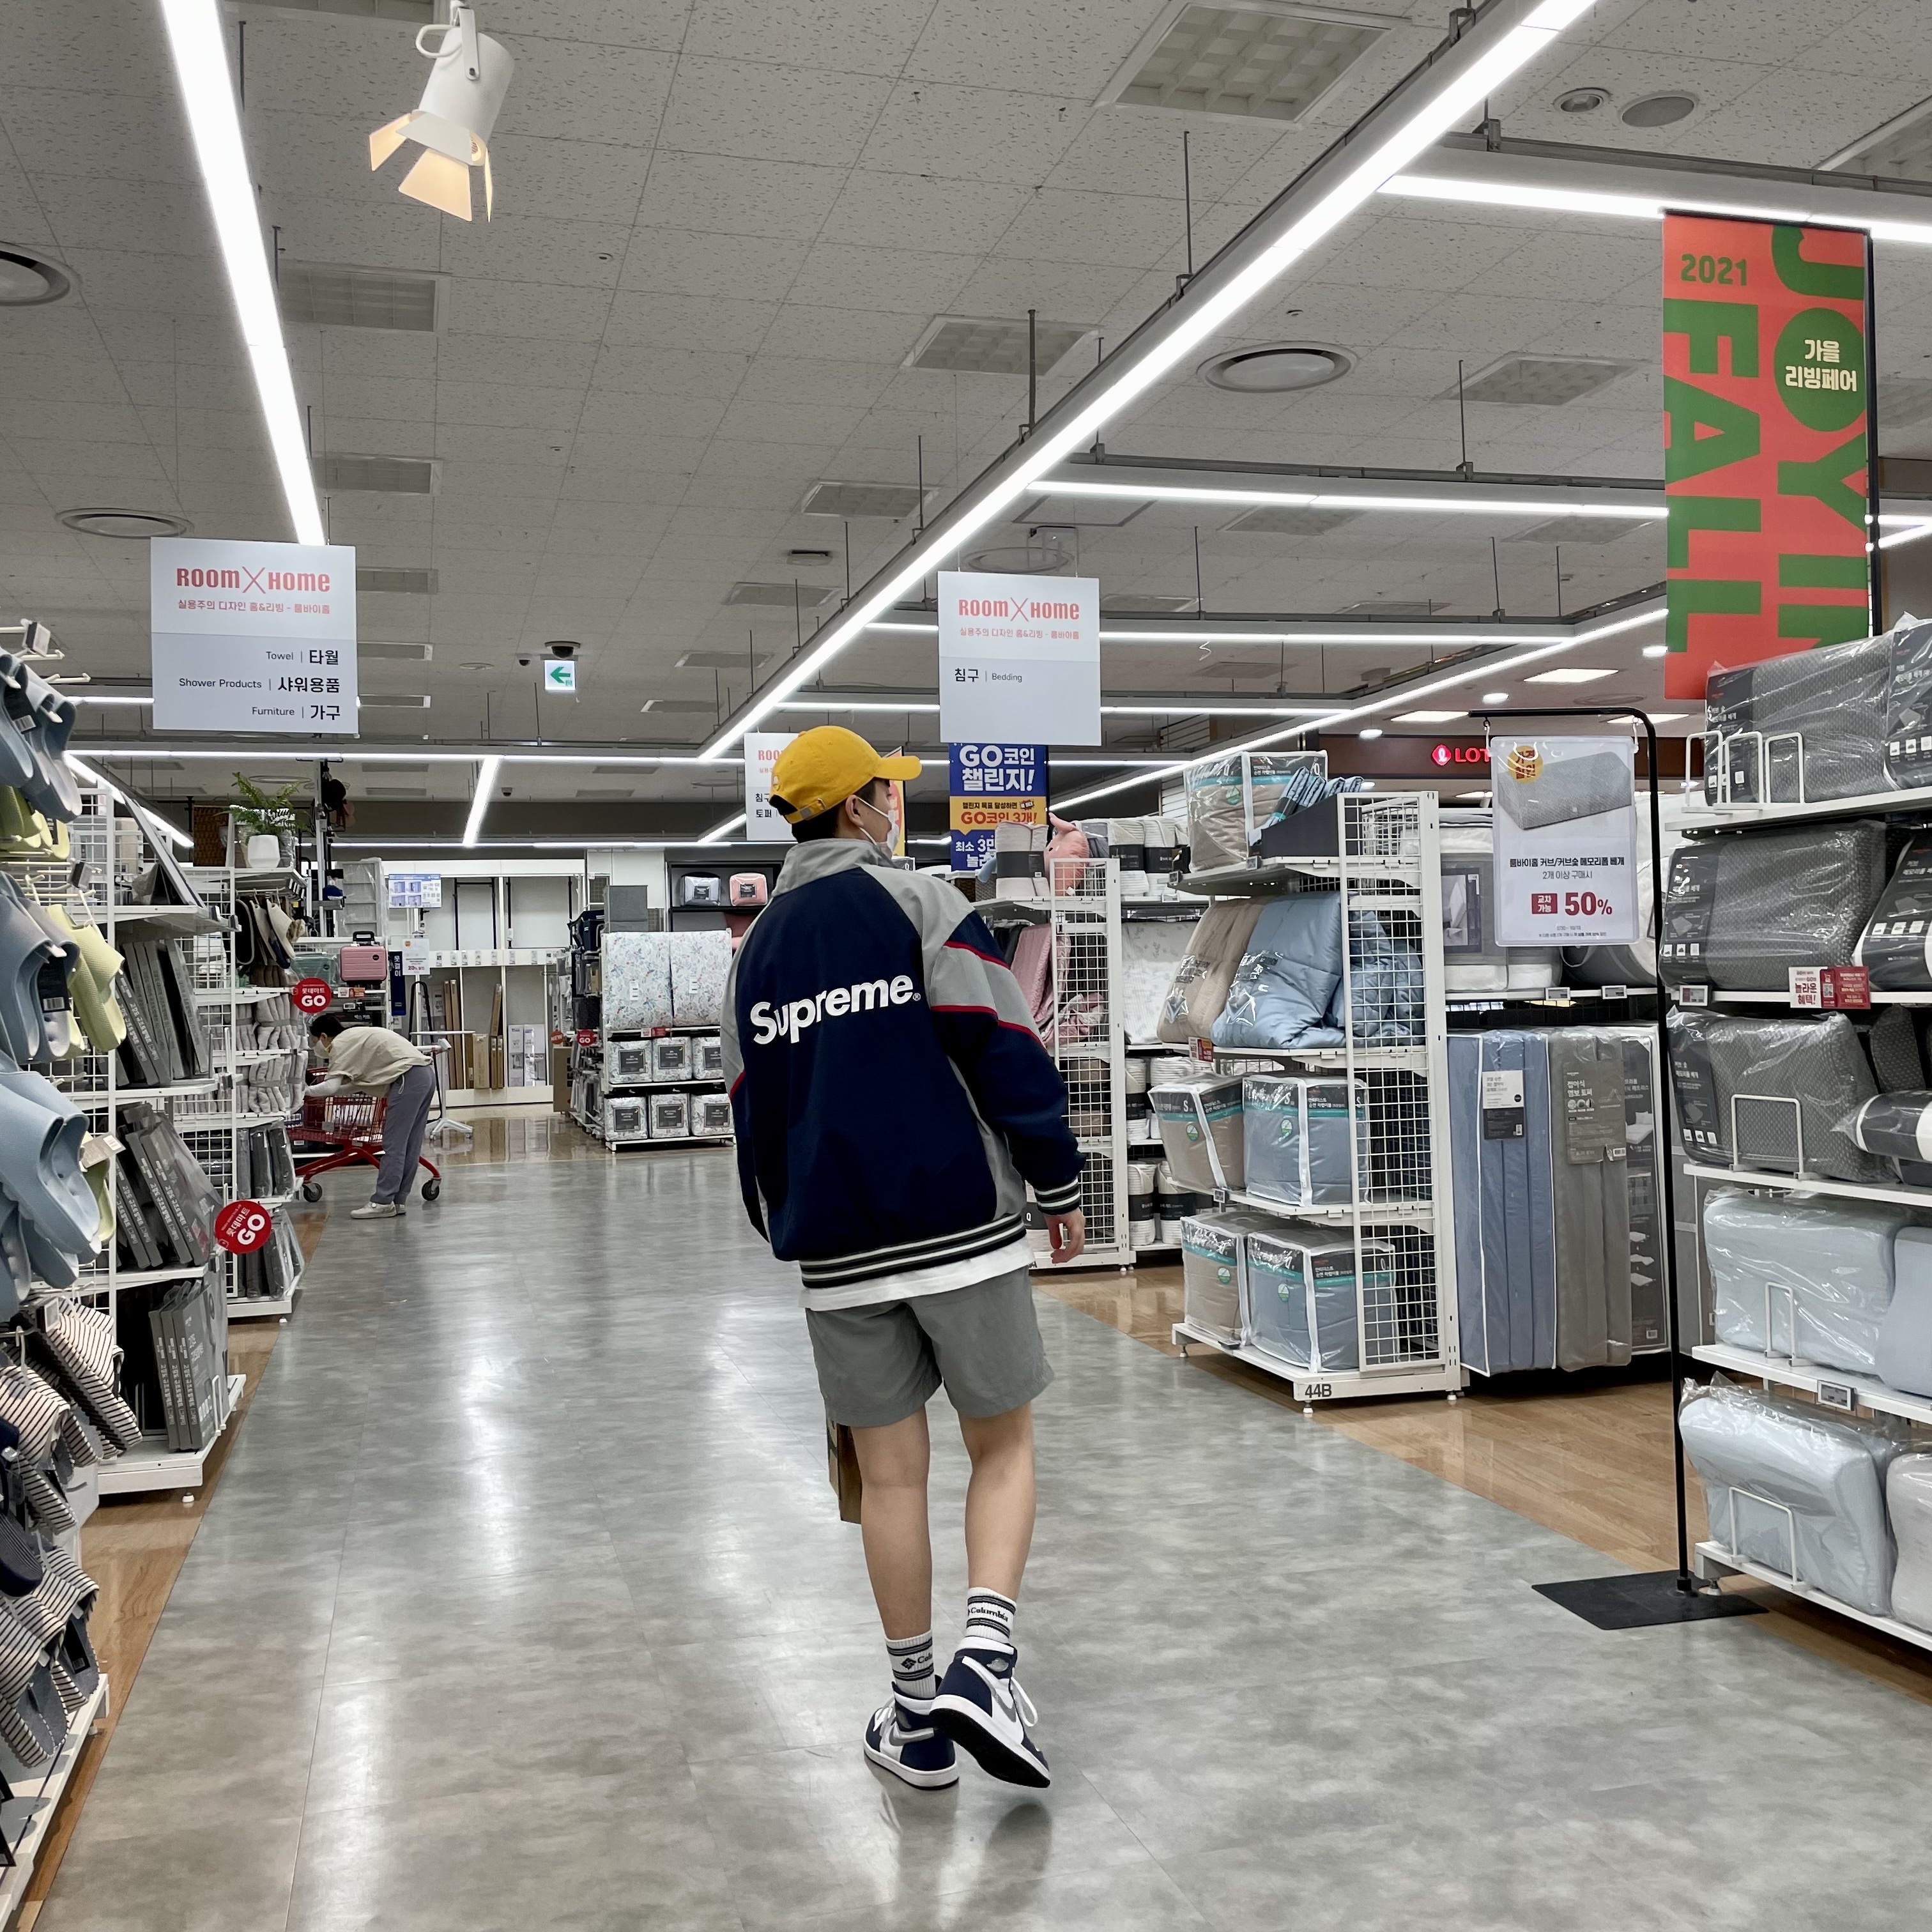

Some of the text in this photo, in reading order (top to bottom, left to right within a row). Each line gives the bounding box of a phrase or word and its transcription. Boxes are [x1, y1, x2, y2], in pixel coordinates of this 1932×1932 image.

[1681, 254, 1747, 286] 2021
[1804, 339, 1841, 364] 가을
[1785, 365, 1857, 392] 리빙페어
[1664, 298, 1761, 653] FALL
[178, 599, 215, 610] 실용주의
[218, 601, 246, 611] 디자인
[250, 602, 284, 613] 홈&리빙
[295, 604, 330, 614] 룸바이홈
[960, 627, 989, 636] 실용주의
[992, 629, 1013, 637] 디자인
[1016, 629, 1043, 638] 홈&리빙
[1051, 630, 1079, 640] 룸바이홈
[266, 650, 339, 665] Towel 타월
[954, 668, 1022, 682] 침구 Bedding
[179, 677, 340, 693] Shower Products 샤워용품
[252, 705, 341, 720] Furniture 가구
[960, 745, 1034, 767] GO코인
[962, 768, 1034, 792] 챌린지!
[756, 809, 772, 818] 토퍼
[961, 811, 1038, 824] GO코인 3개!
[955, 841, 974, 852] 최소
[1510, 857, 1625, 867] 룸바이홈 커브/커브숯 메모리폼 베개
[1543, 871, 1593, 879] 2개 이상 구매시
[1538, 905, 1551, 913] 가능
[1565, 892, 1613, 916] 50%
[1795, 983, 1817, 993] 놀라운
[302, 995, 326, 1007] GO
[1798, 994, 1816, 1005] 혜택!
[750, 975, 914, 1045] Supreme
[1567, 1080, 1585, 1089] 접이식
[1183, 1100, 1188, 1112] S
[226, 1208, 250, 1237] 롯데마트
[237, 1214, 265, 1245] GO
[1305, 1384, 1332, 1398] 44B
[970, 1606, 1008, 1621] Columbia
